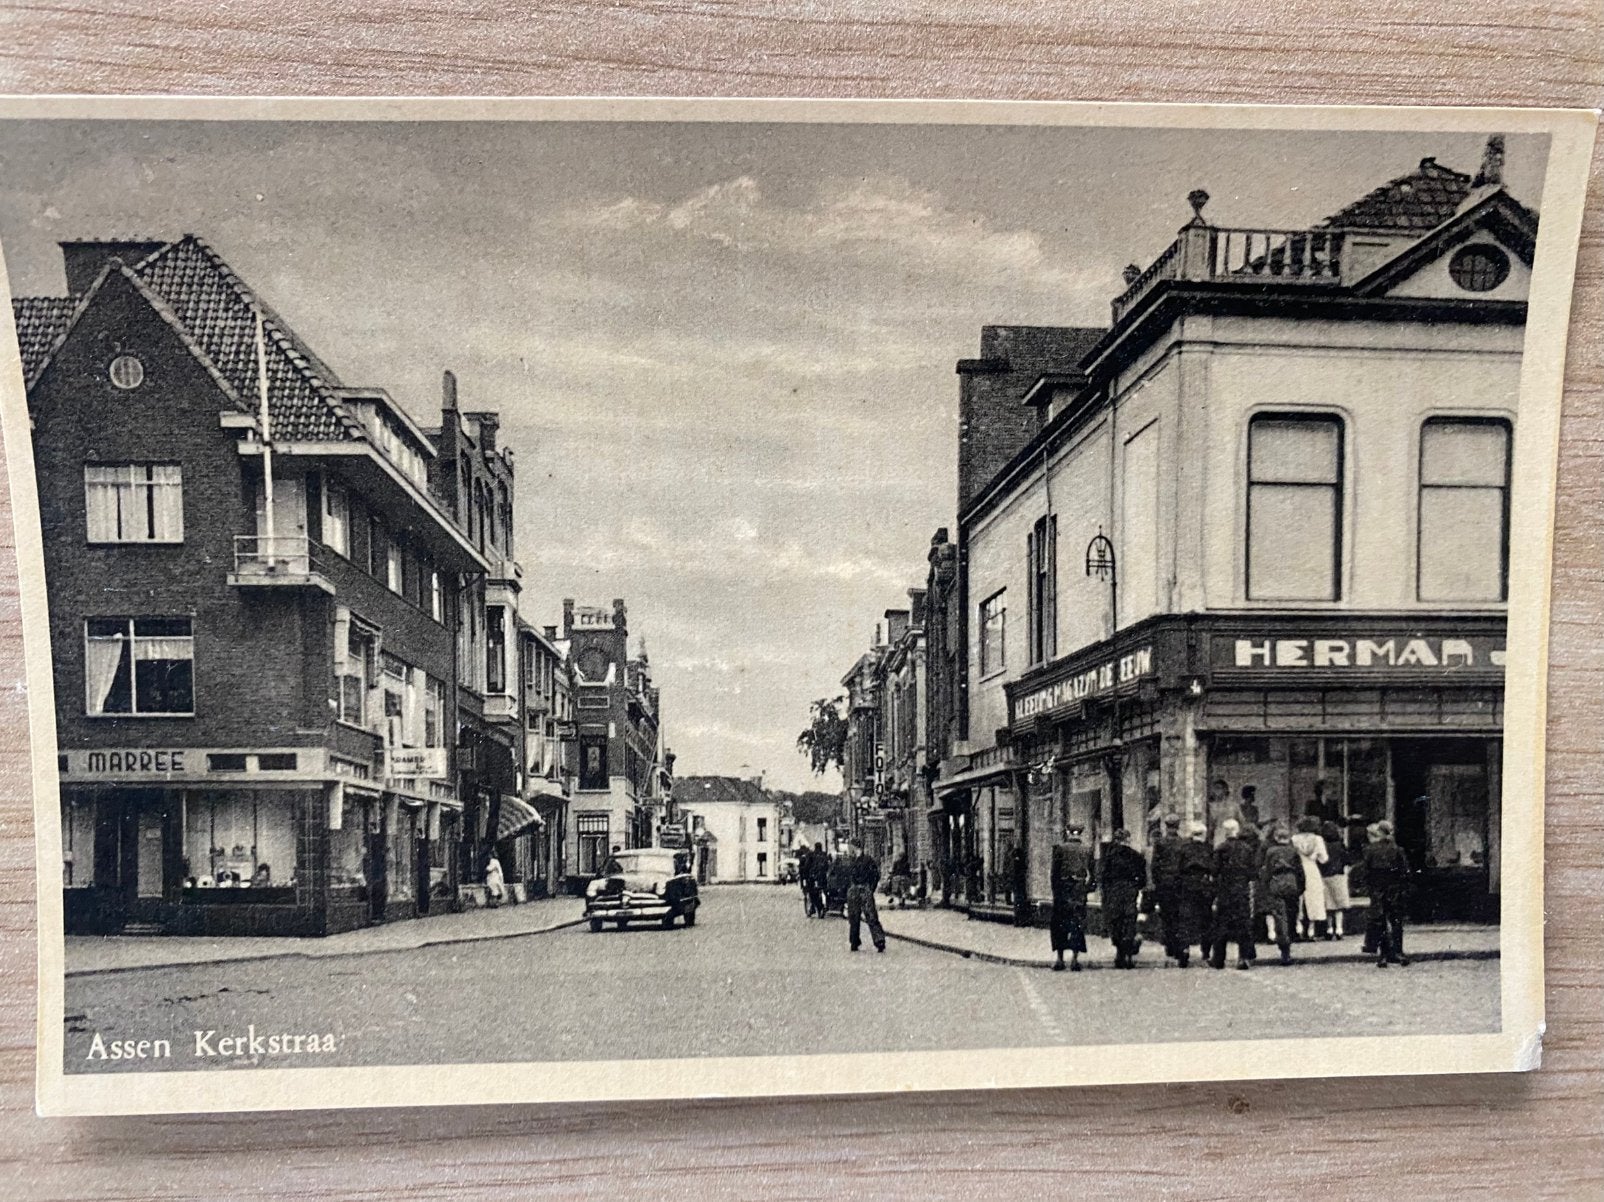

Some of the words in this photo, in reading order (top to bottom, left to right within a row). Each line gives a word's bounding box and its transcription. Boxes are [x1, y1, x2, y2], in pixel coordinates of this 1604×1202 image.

[1235, 639, 1473, 666] HERMAN
[88, 752, 184, 772] MARREE
[875, 743, 884, 795] FOTO
